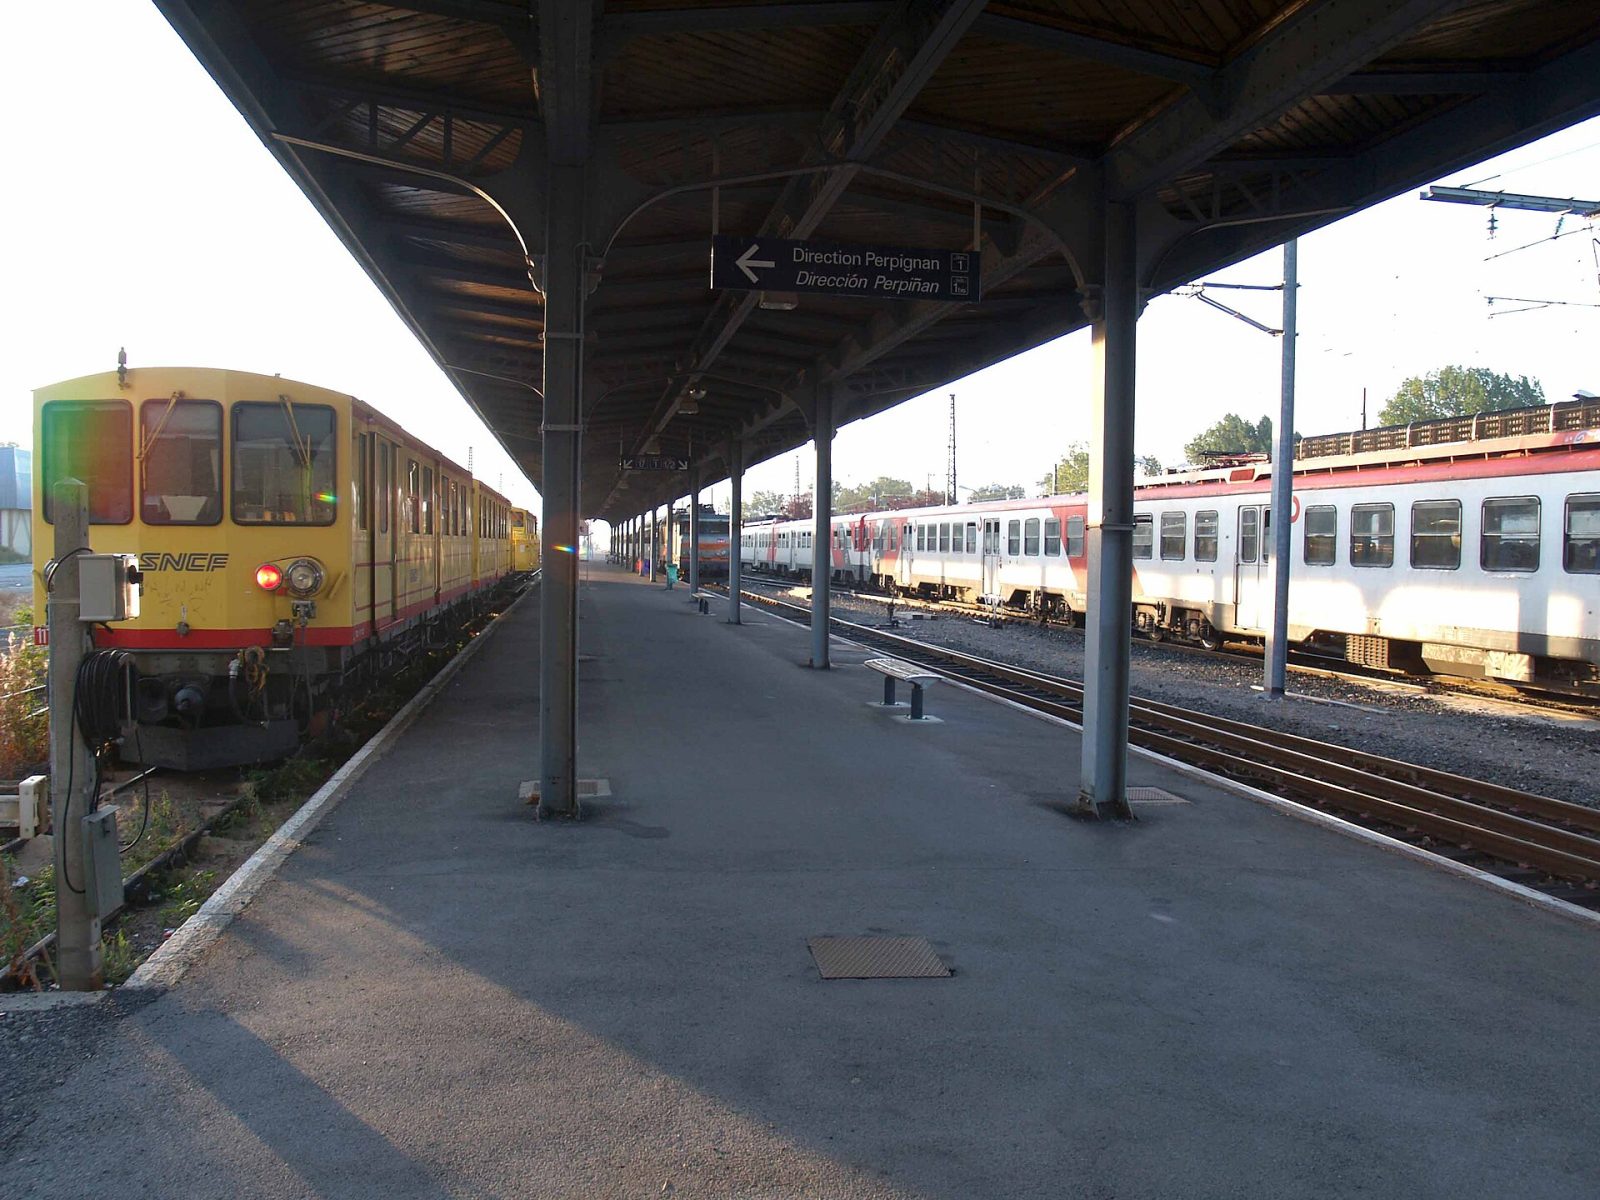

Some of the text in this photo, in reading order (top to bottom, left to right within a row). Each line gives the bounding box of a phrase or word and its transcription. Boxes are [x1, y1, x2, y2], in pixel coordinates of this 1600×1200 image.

[793, 247, 940, 272] Direction Perpignan
[796, 270, 940, 294] Dirección Perpiñan
[139, 552, 230, 572] SNCF
